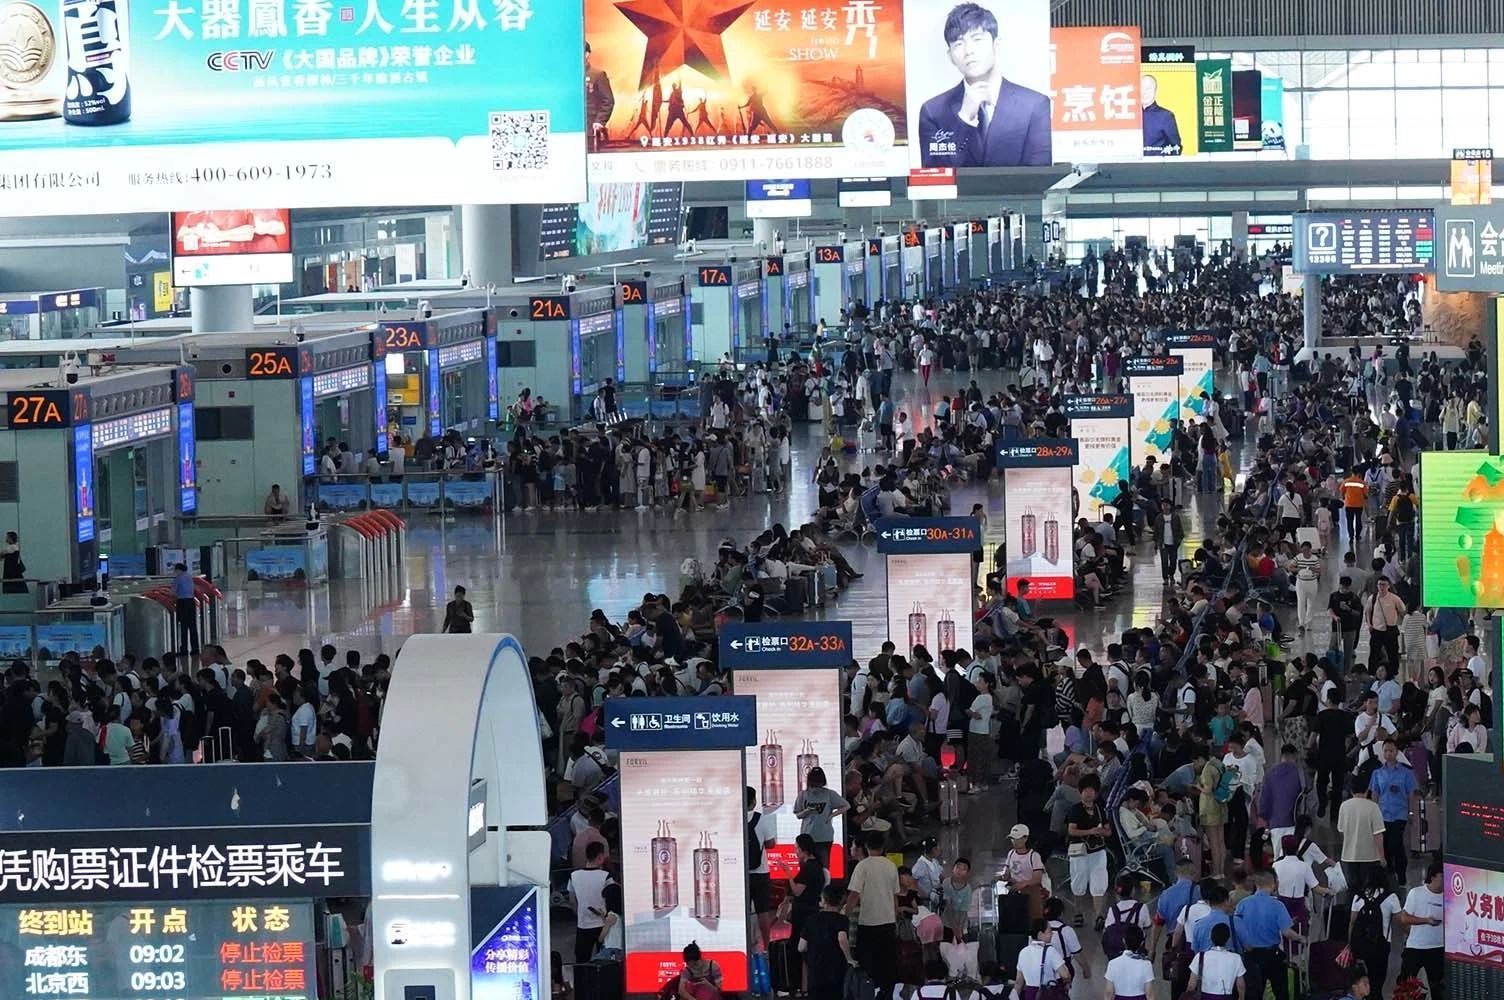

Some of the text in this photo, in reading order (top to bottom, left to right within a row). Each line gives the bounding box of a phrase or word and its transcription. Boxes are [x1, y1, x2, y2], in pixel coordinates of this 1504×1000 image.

[355, 0, 533, 35] 人生从容
[754, 0, 882, 59] 延安 延安 秀
[206, 51, 274, 72] CCTV
[789, 48, 838, 60] SHOW
[719, 155, 833, 171] 0911-7661888
[817, 249, 841, 261] 13A
[701, 269, 726, 284] 17A
[622, 285, 642, 301] 9A
[532, 299, 564, 318] 21A
[386, 327, 421, 347] 23A
[249, 352, 292, 375] 25A
[13, 397, 63, 424] 27A
[927, 527, 974, 540] 30A-31A
[762, 635, 845, 652] 检票口 32A-33A
[664, 712, 739, 724] 卫生间 饮用水
[18, 905, 290, 936] 终到站 开点 状态
[24, 942, 305, 967] 成都东 09:02 停止检票
[25, 969, 305, 994] 北京西 09:03 停止检票
